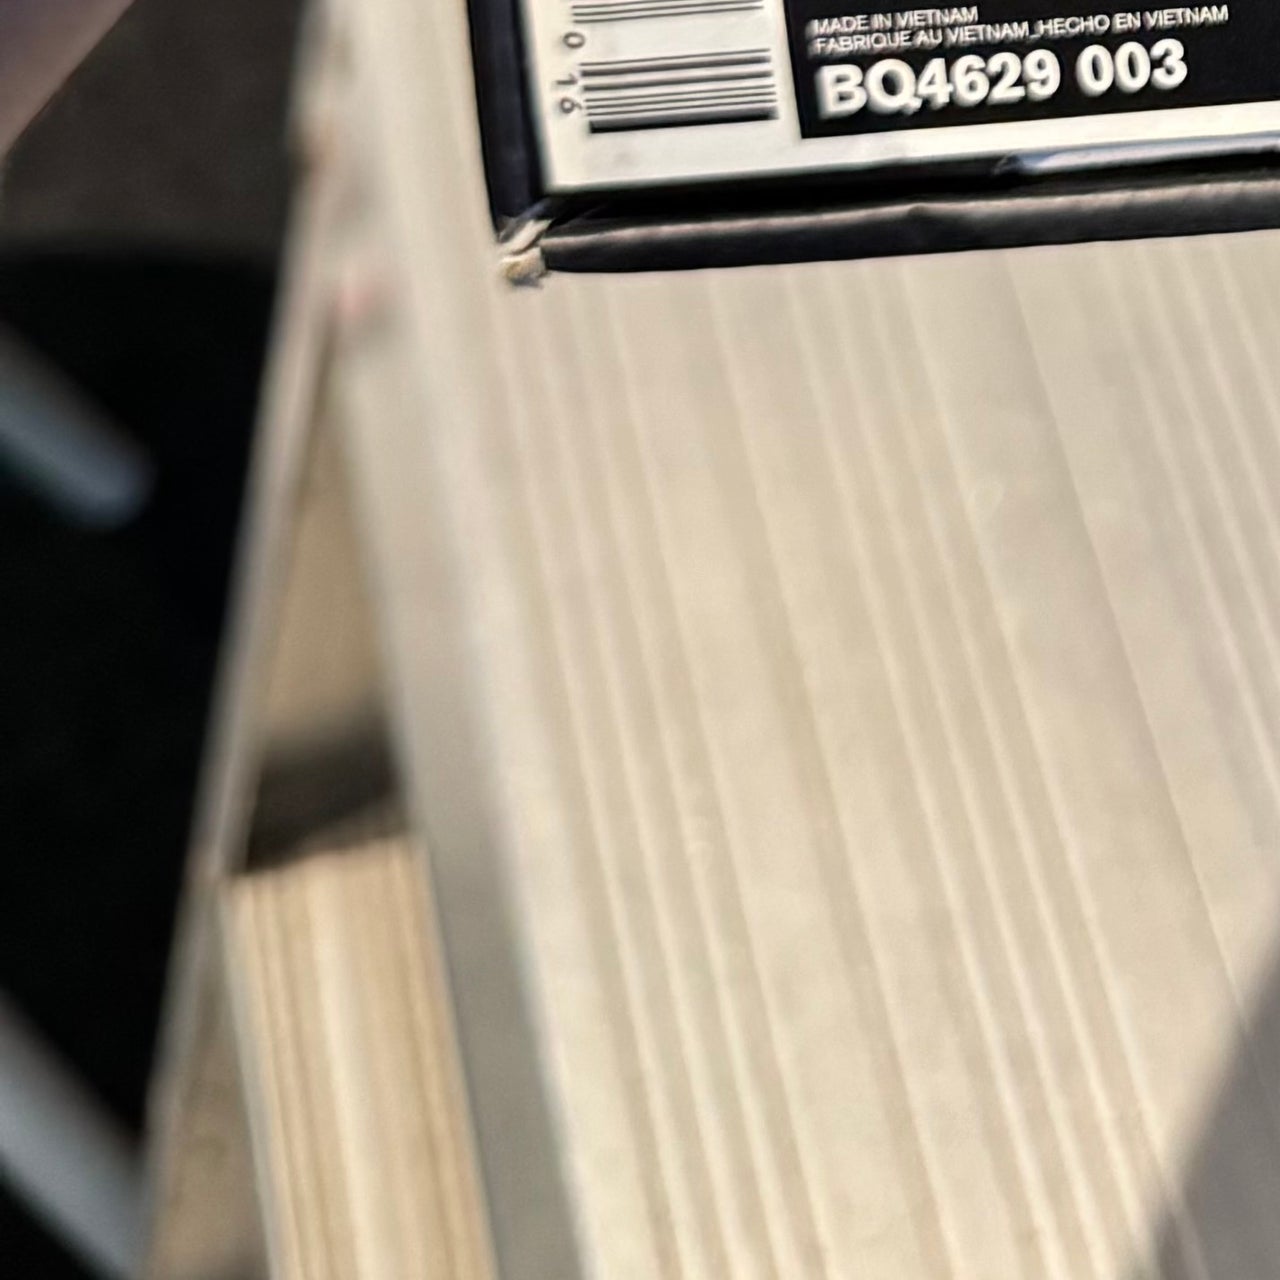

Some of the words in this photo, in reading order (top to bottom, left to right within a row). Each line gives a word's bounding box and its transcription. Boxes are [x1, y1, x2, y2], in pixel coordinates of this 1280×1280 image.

[807, 17, 869, 37] MADE
[870, 12, 893, 32] IN
[894, 6, 978, 29] VIETNAM
[807, 30, 913, 59] FABRIQUE
[915, 28, 943, 47] AU
[1111, 11, 1141, 33] EN
[1141, 5, 1229, 30] VIETNAM
[814, 48, 1061, 120] BQ4629
[1074, 38, 1188, 97] 003
